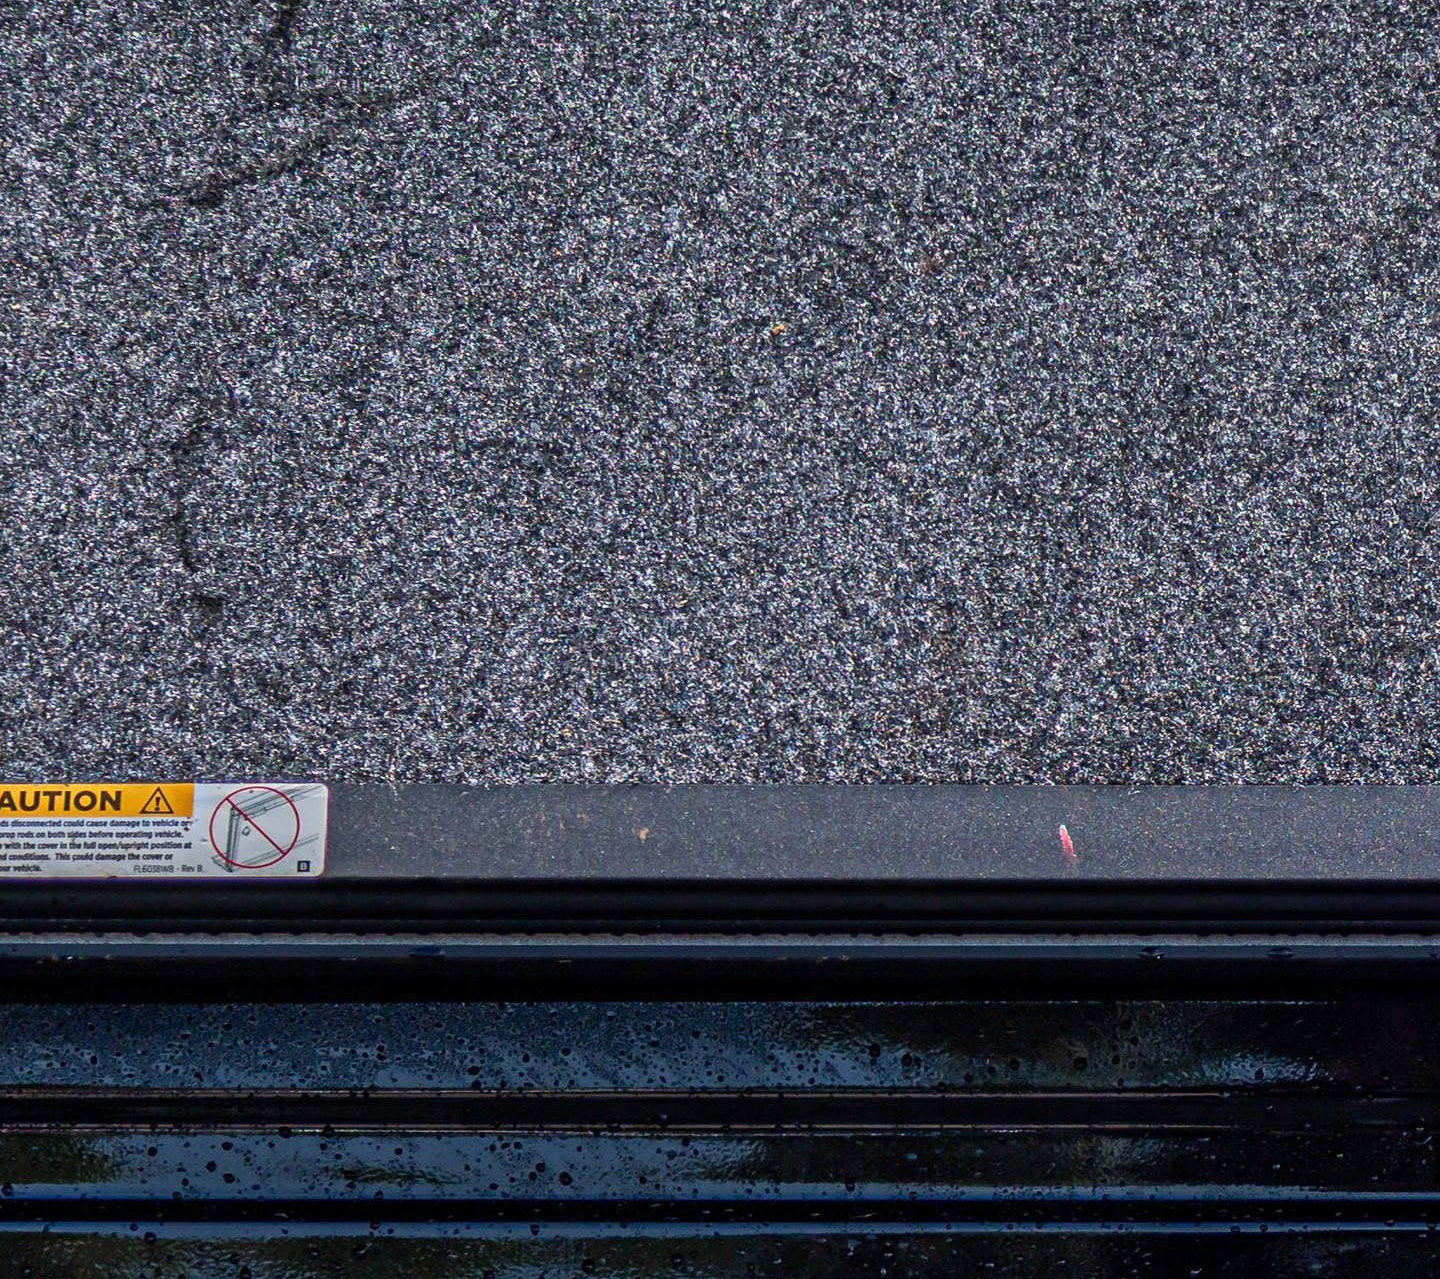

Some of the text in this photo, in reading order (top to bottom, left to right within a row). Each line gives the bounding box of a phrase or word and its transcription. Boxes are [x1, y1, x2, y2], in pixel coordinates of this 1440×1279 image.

[110, 820, 140, 828] damage
[116, 831, 153, 839] operating
[151, 842, 182, 850] position
[95, 853, 126, 861] damage
